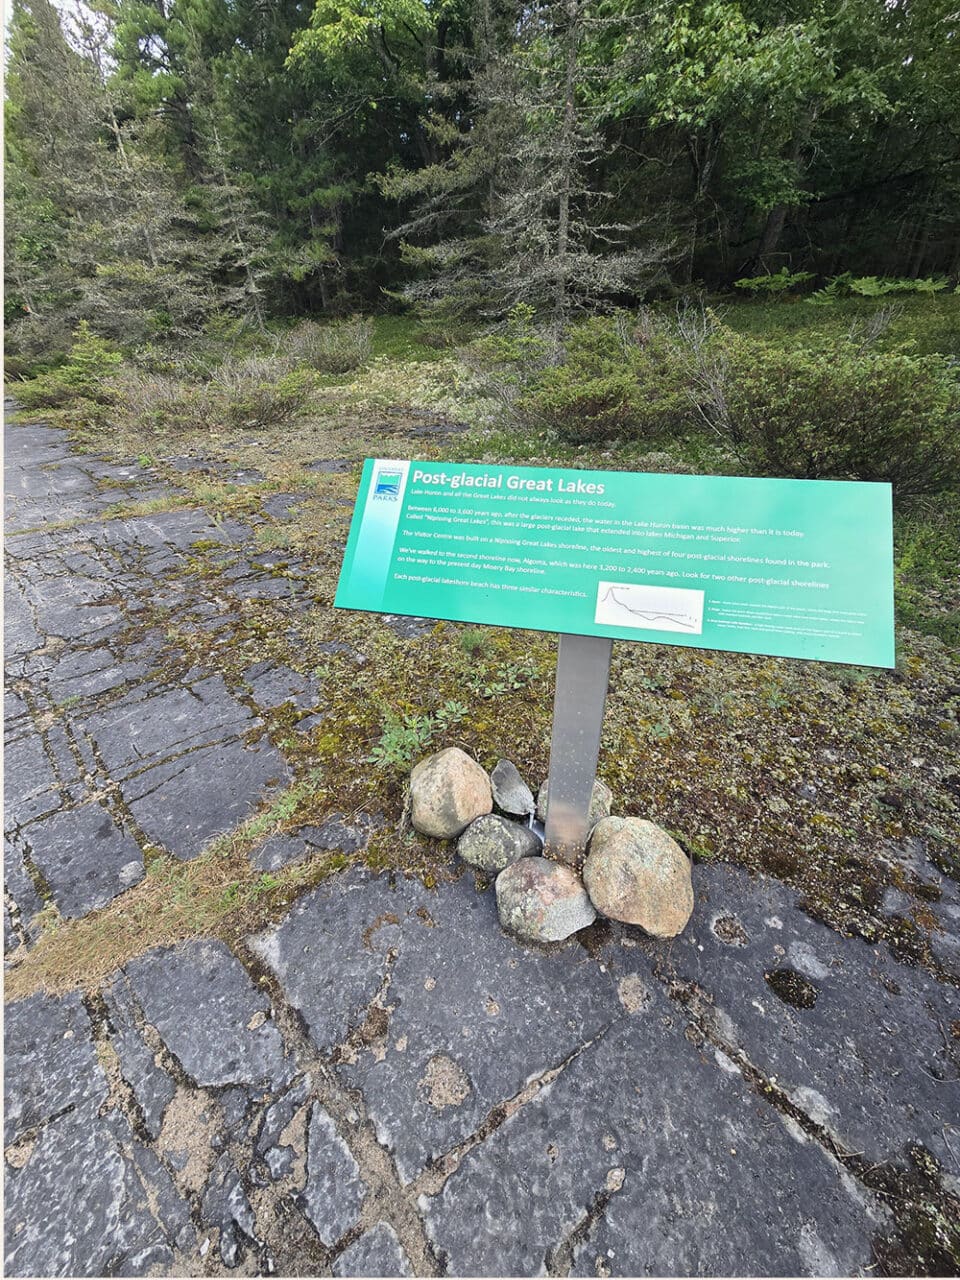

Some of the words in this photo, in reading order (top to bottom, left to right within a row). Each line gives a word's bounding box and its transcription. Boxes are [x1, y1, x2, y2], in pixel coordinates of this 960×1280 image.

[412, 469, 502, 488] Post-glacial
[506, 475, 553, 492] Great
[557, 478, 605, 495] Lakes
